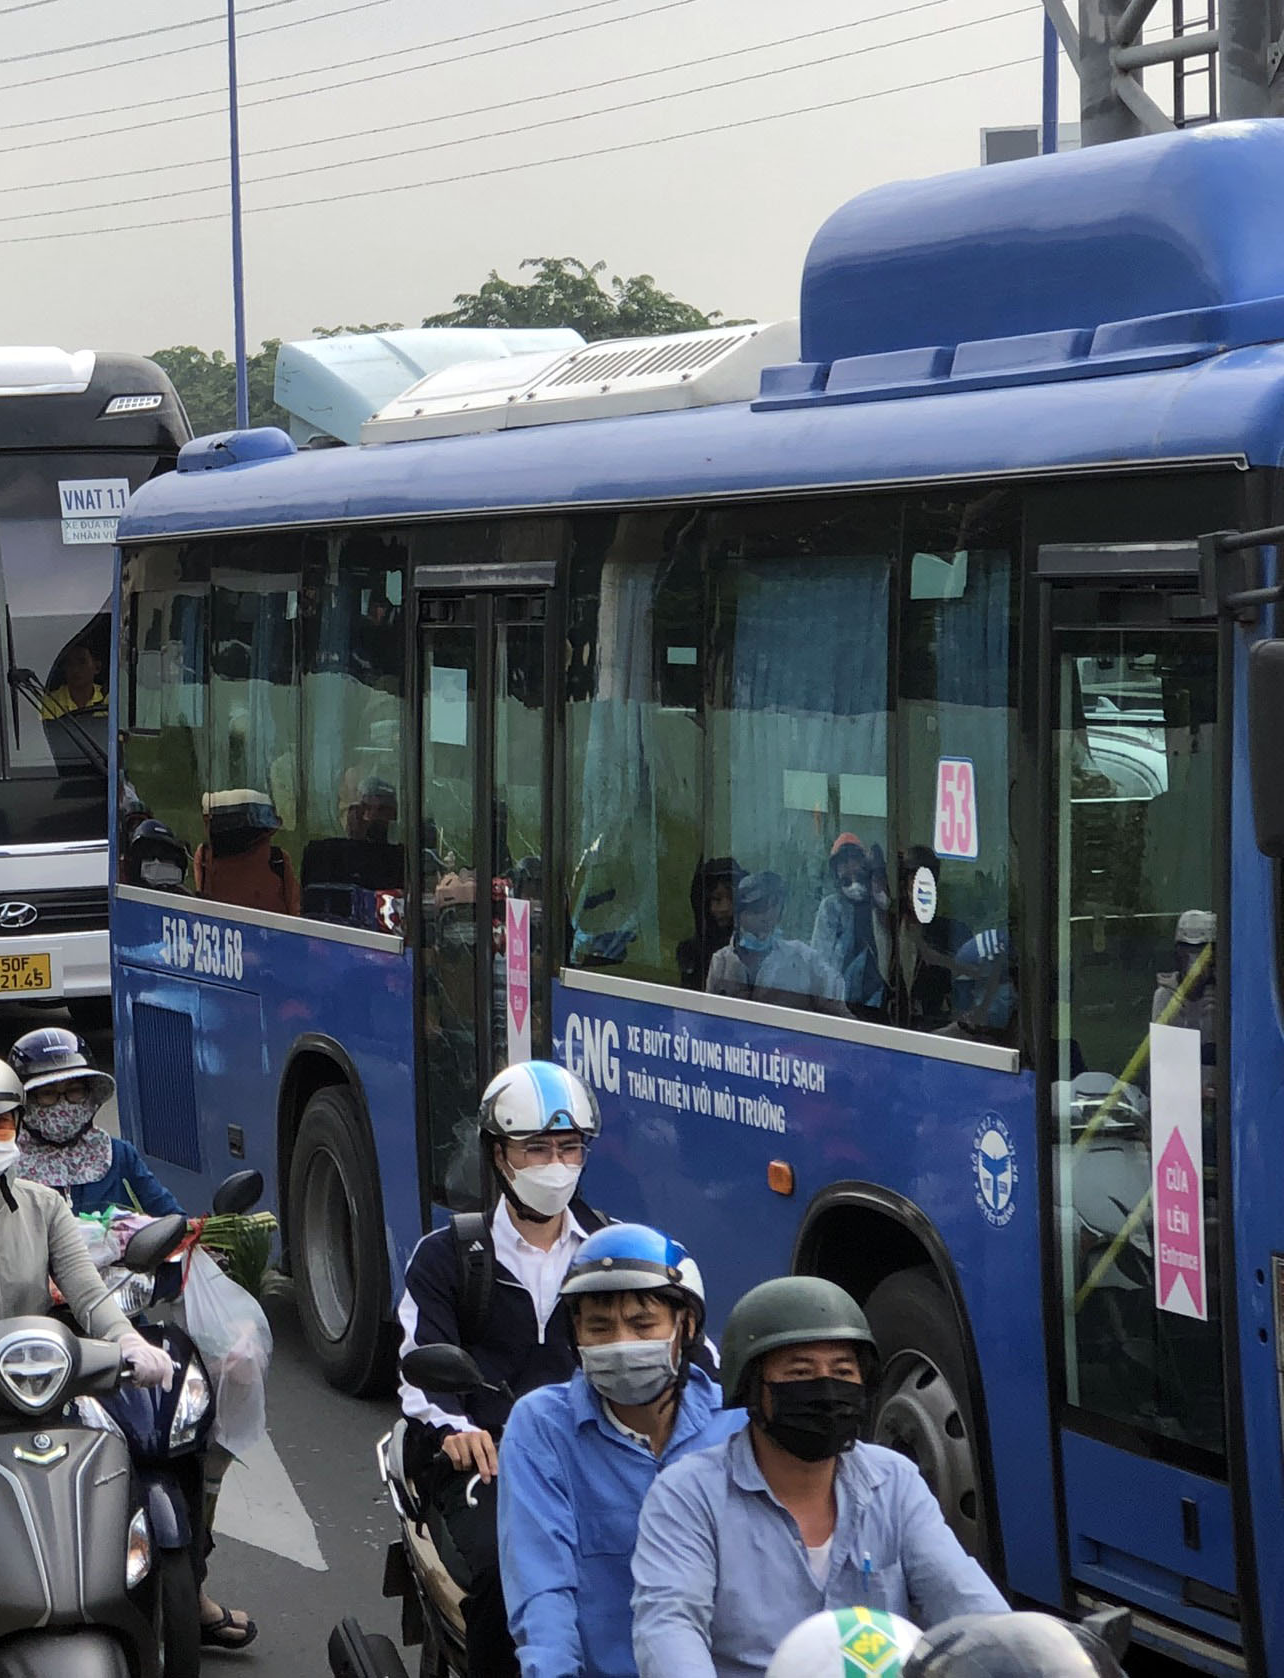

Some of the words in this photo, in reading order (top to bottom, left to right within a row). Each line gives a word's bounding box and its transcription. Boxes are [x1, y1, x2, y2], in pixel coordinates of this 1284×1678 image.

[62, 488, 103, 511] VNAT
[106, 488, 126, 509] 1.1
[66, 520, 79, 529] XE
[941, 764, 972, 854] 53
[162, 914, 244, 981] 51B-253.68
[0, 957, 30, 973] 50F
[565, 1012, 621, 1095] CNG
[627, 1025, 642, 1053] XE
[643, 1024, 671, 1059] BUÝT
[673, 1026, 690, 1064] SỬ
[691, 1037, 723, 1073] DỤNG
[724, 1042, 760, 1080] NHIÊN
[762, 1047, 790, 1089] LIỆU
[792, 1059, 826, 1096] SẠCH
[627, 1068, 656, 1102] THÂN
[657, 1074, 691, 1114] THIỆN
[692, 1080, 712, 1116] VỚI
[714, 1085, 736, 1122] MÔI
[738, 1093, 786, 1135] TRƯỜNG
[1166, 1160, 1189, 1194] CỬA
[1167, 1204, 1190, 1235] LÊN
[1160, 1242, 1199, 1272] Entrance
